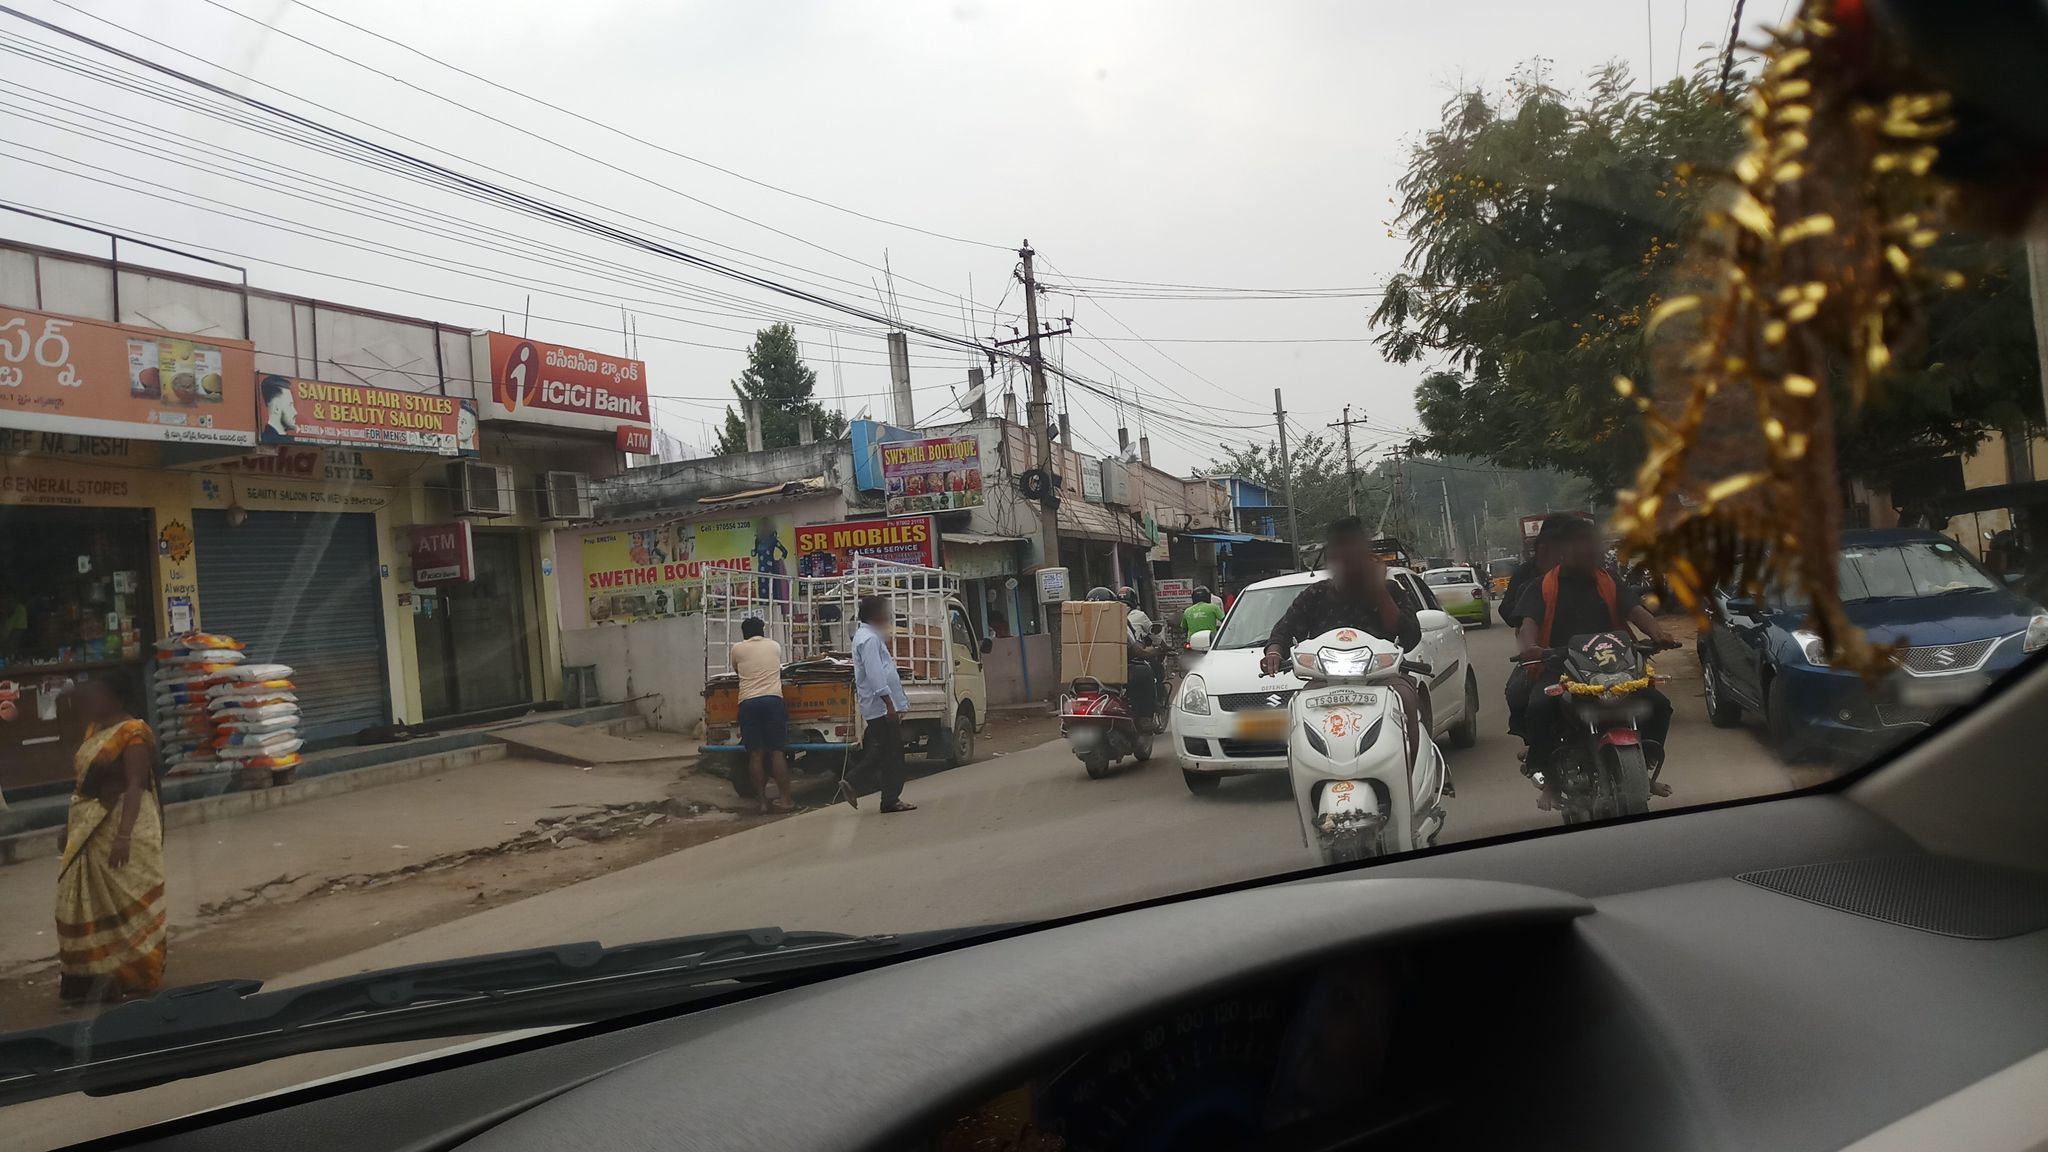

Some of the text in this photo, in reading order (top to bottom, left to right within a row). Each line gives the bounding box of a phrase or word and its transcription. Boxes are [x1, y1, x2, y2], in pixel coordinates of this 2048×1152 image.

[298, 382, 453, 415] SAVITHA HAIR STYLES
[541, 380, 643, 416] ICICI Bank
[313, 403, 443, 431] & BEAUTY SALOON
[365, 428, 381, 440] FOR
[626, 432, 648, 449] ATM
[325, 449, 363, 466] HAIR
[884, 440, 977, 466] SWETHA BOUTIQUE
[325, 466, 374, 481] STYLES
[2, 477, 129, 496] GENERAL STORES
[418, 533, 456, 553] ATM
[799, 525, 927, 551] SR MOBILES
[848, 548, 876, 556] SLES
[884, 543, 918, 553] SERVICE
[589, 564, 658, 589] SWETHA
[164, 583, 196, 596] Always
